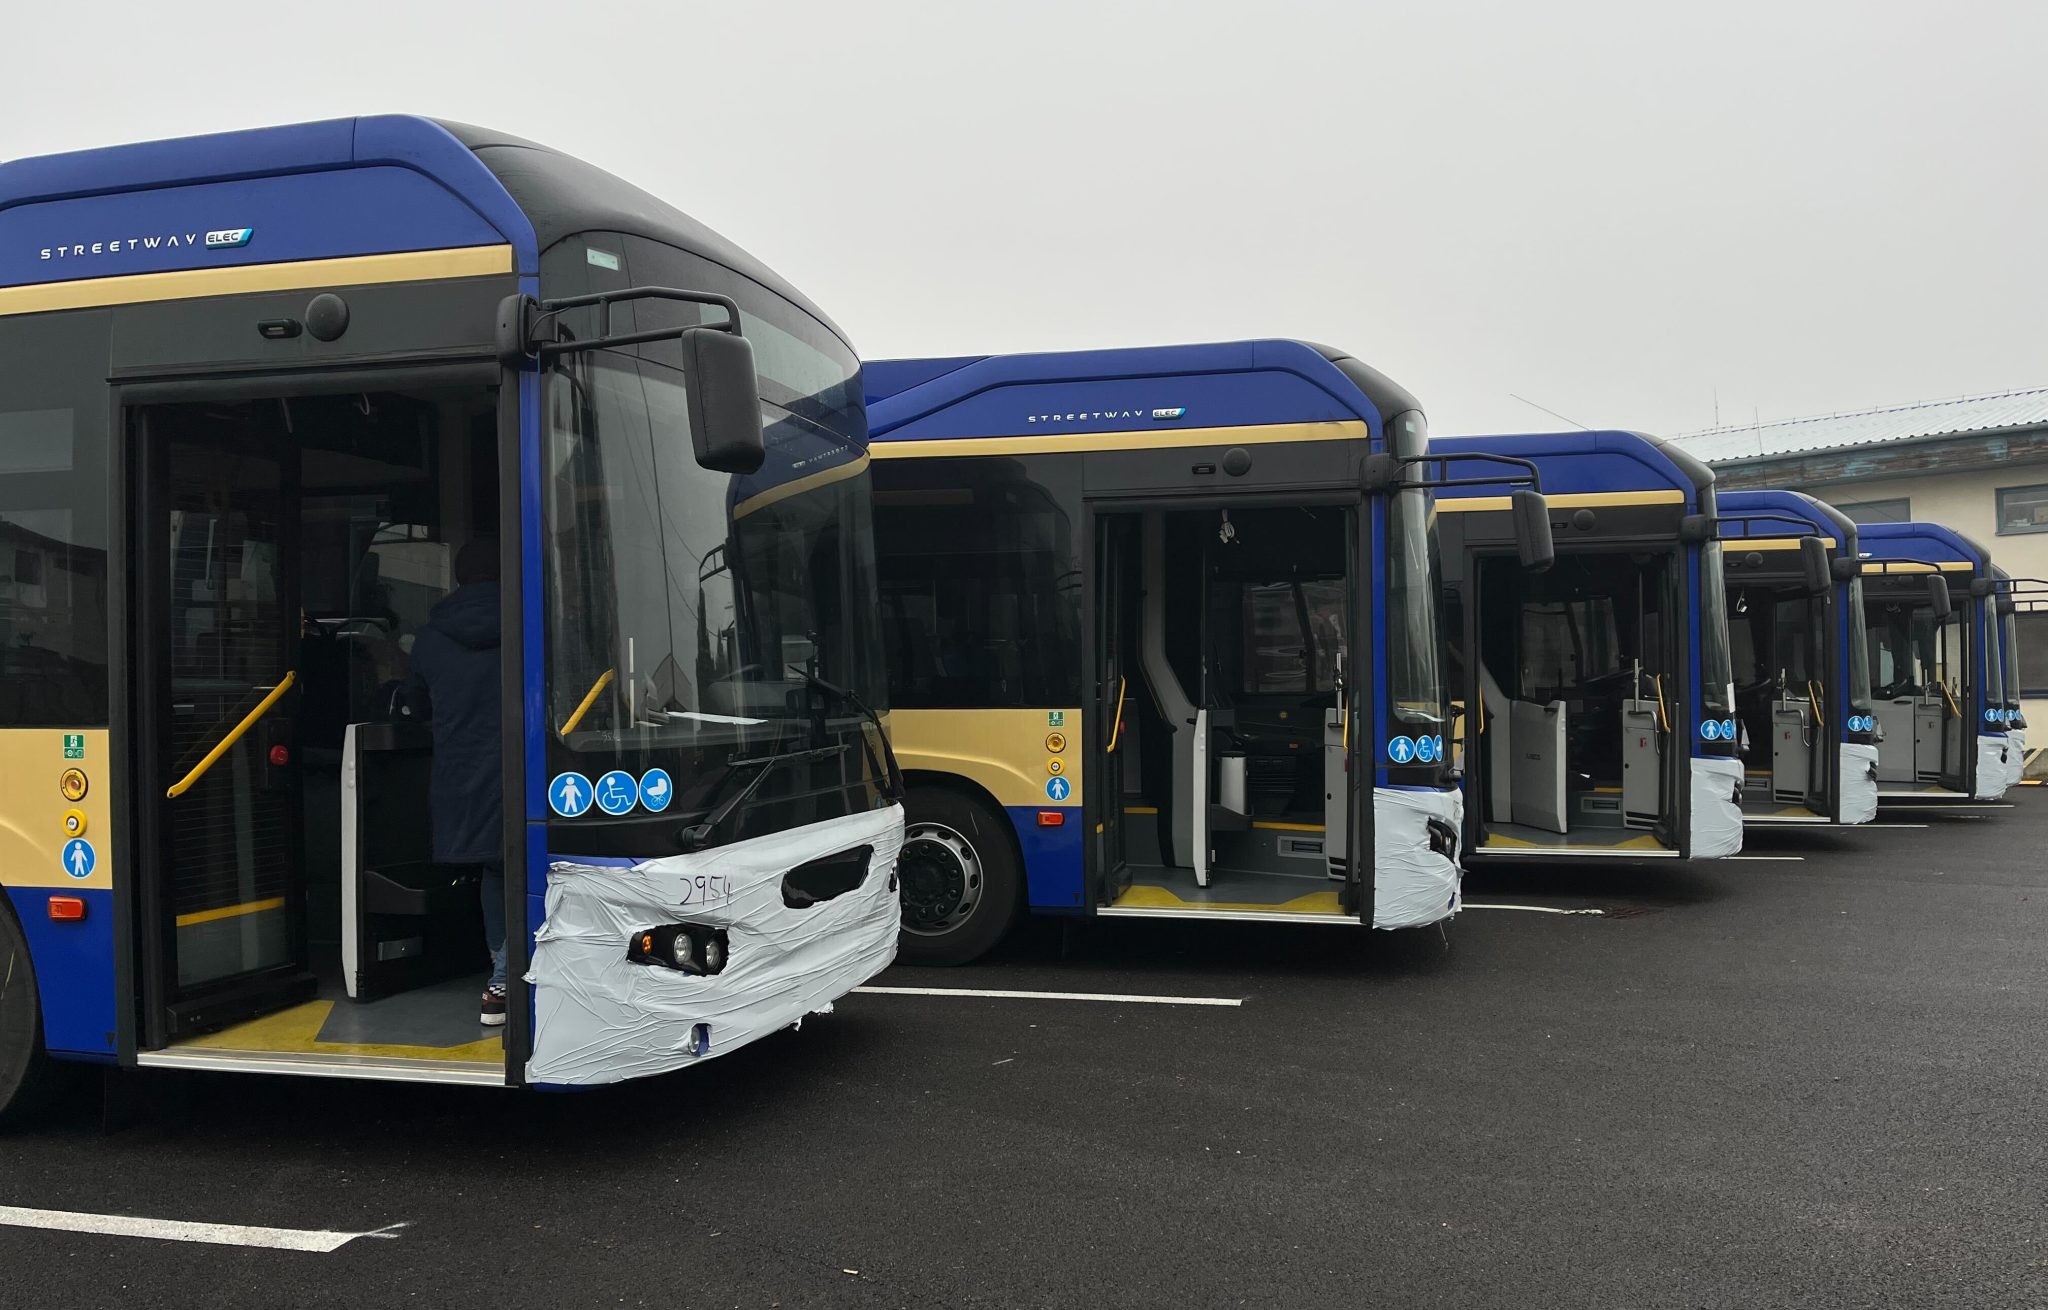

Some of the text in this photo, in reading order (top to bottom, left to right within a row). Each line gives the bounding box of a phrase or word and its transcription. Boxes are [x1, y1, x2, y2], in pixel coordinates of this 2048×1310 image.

[40, 232, 239, 259] STREETWAY ELEC
[1028, 410, 1177, 423] STREETWAY ELEC
[679, 875, 733, 906] 2954
